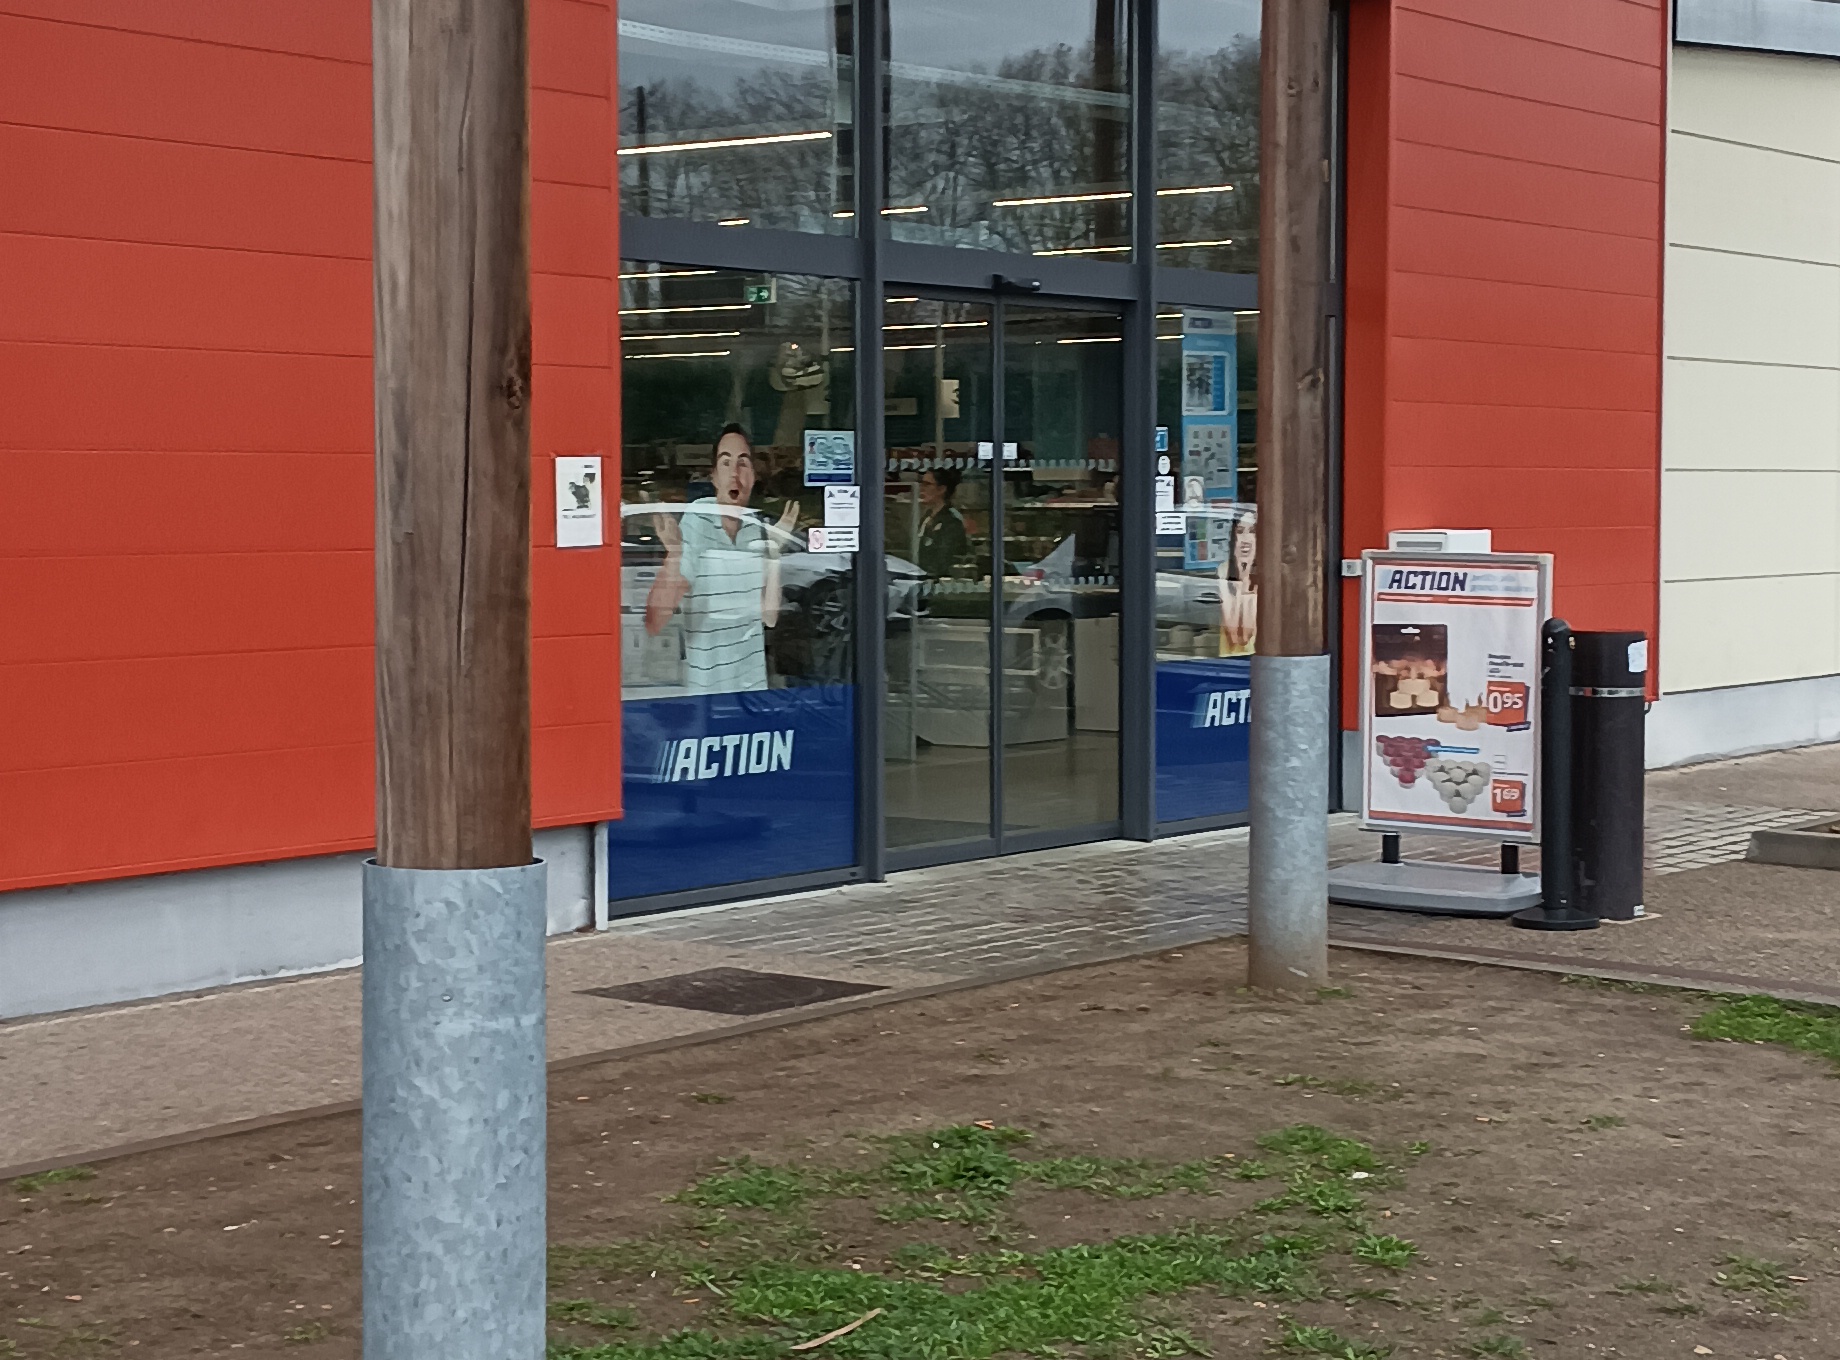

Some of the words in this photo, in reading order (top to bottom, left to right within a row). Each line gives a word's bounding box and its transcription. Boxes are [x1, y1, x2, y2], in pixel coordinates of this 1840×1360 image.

[1388, 569, 1468, 591] ACTION
[1204, 688, 1252, 728] ACT
[671, 729, 795, 782] ACTION
